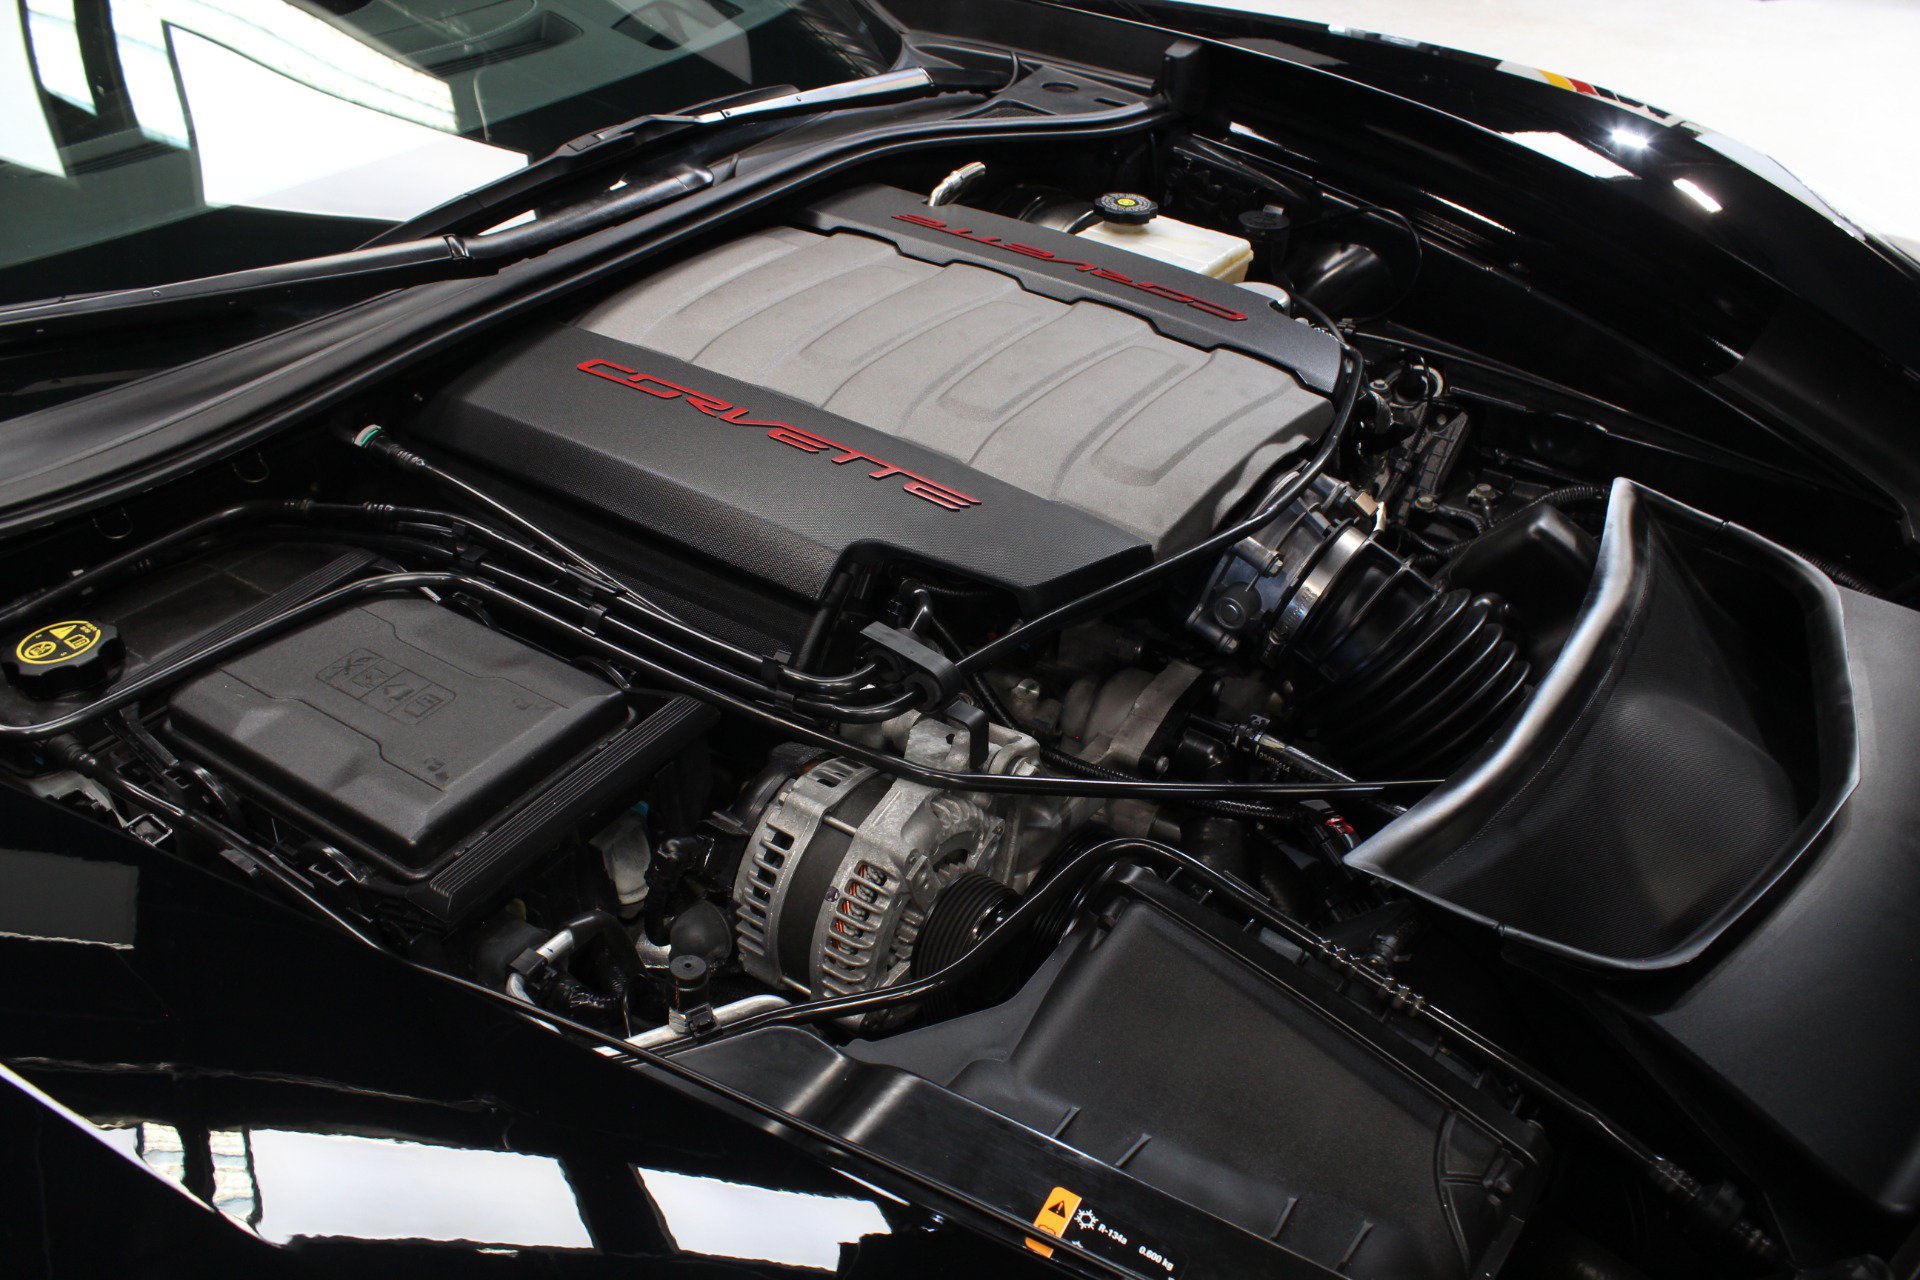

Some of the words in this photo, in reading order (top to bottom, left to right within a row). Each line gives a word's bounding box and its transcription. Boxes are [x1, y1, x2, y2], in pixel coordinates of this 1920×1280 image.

[891, 213, 1248, 321] CORVETTE
[577, 358, 982, 511] CORVETTE
[1098, 1223, 1128, 1245] R-134a
[1162, 1258, 1174, 1271] kg
